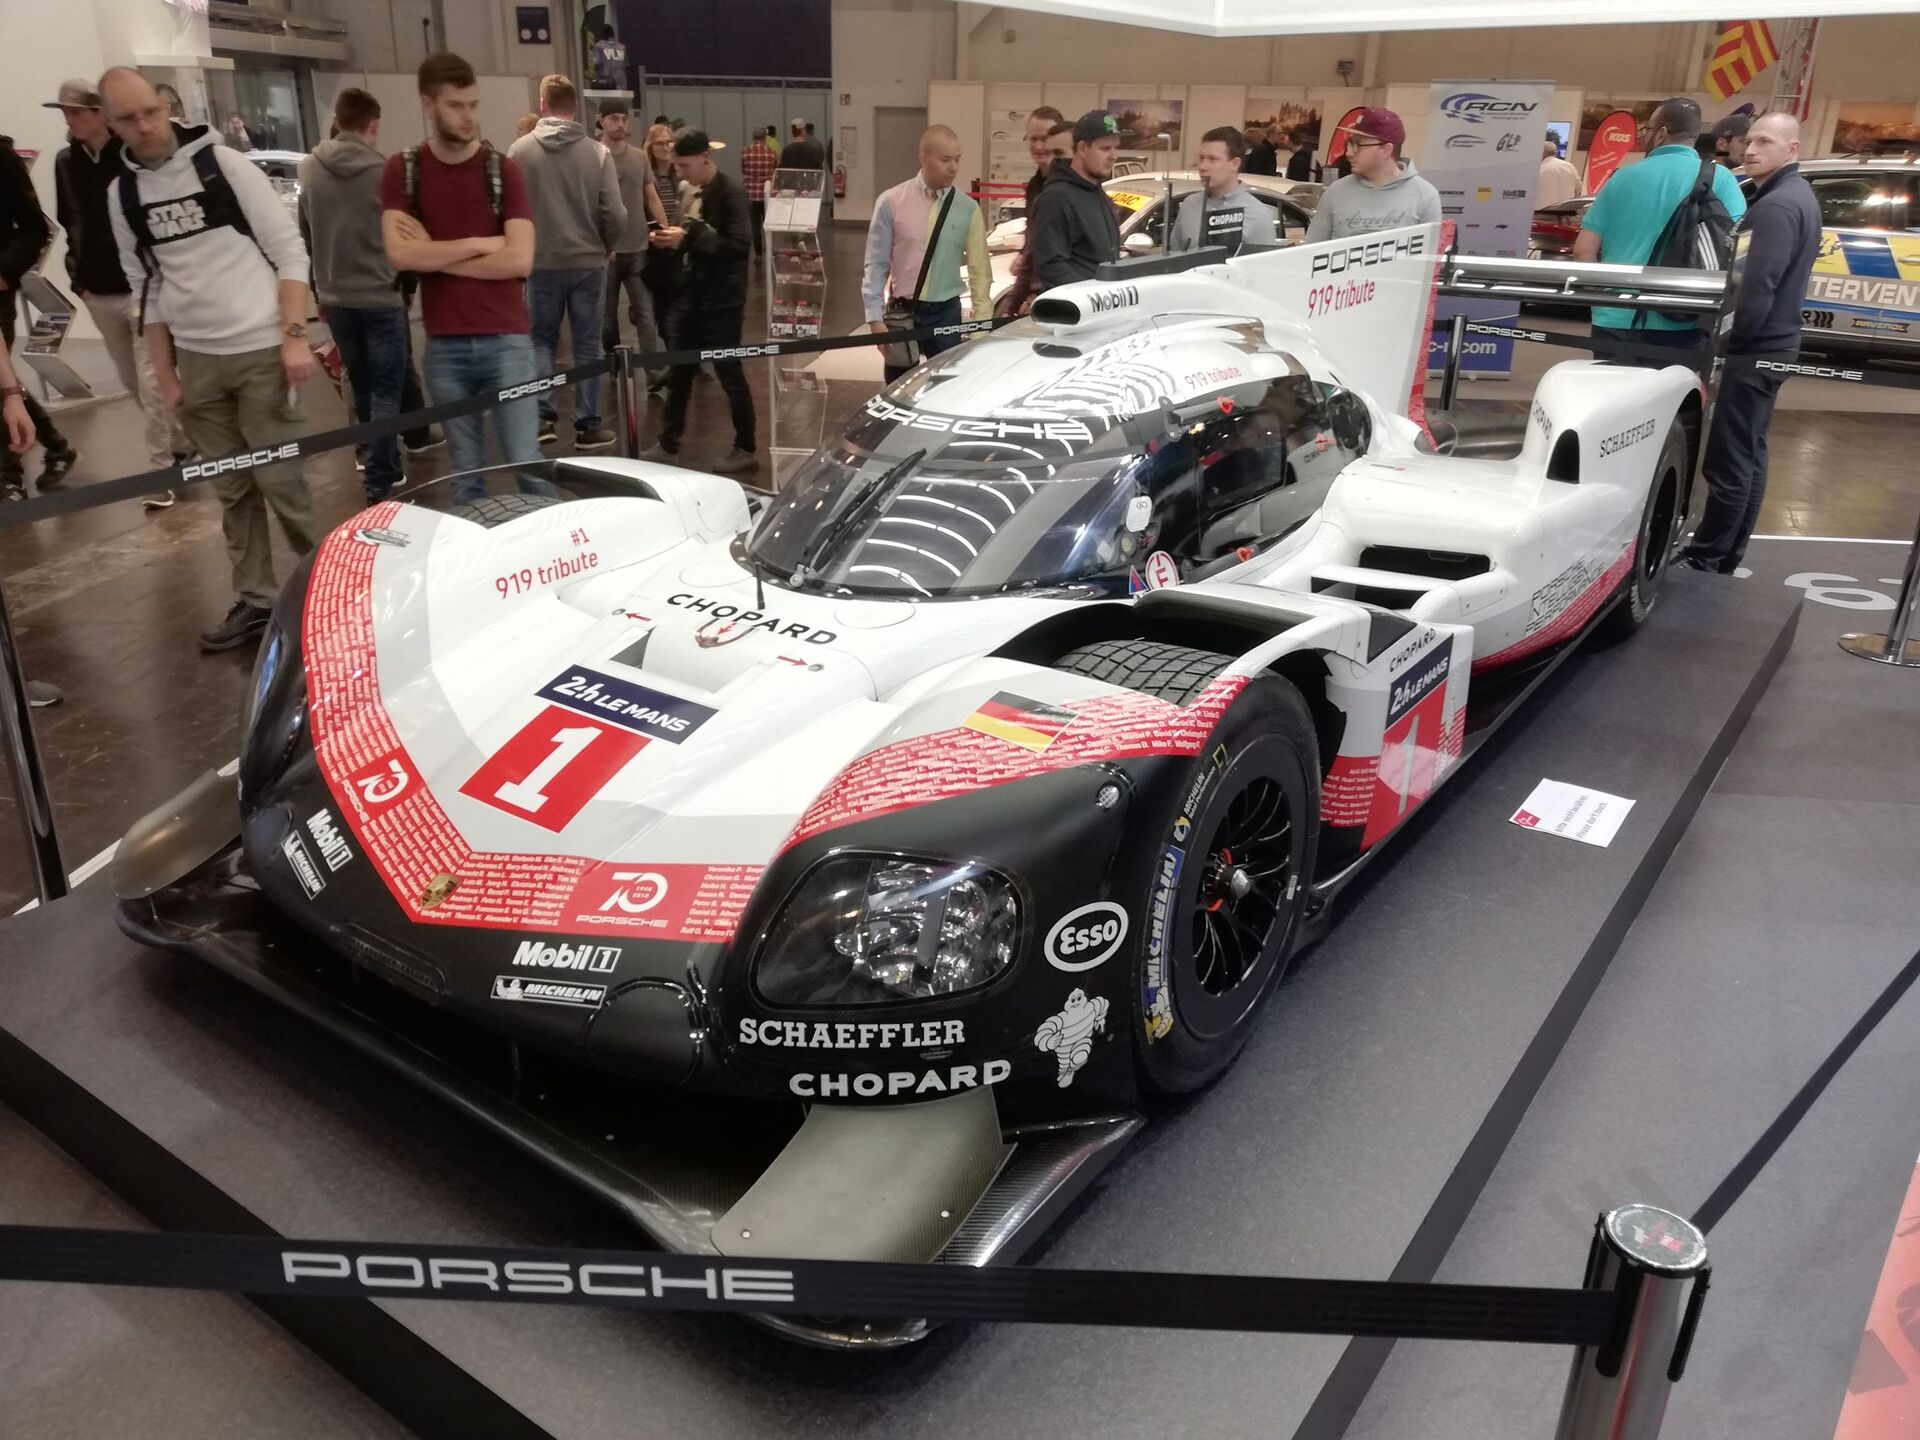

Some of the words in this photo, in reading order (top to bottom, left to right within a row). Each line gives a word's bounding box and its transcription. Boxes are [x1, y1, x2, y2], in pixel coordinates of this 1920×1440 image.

[602, 48, 625, 62] VLN
[1464, 102, 1539, 112] RCN
[147, 199, 205, 221] STAR
[148, 217, 208, 240] WARS
[1209, 212, 1243, 226] CHOPARD
[1311, 234, 1425, 279] PORSCHE
[1086, 288, 1127, 313] Mobil
[1308, 284, 1333, 319] 919
[1335, 278, 1375, 311] tribute
[933, 320, 993, 336] PORSCHE
[1466, 323, 1547, 342] PORSCHE
[700, 344, 780, 361] PORSCHE
[1755, 360, 1863, 381] PORSCHE
[498, 373, 567, 402] PORSCHE
[1184, 371, 1208, 390] 919
[1207, 365, 1243, 384] tribute
[866, 393, 1092, 442] PORSCHE
[1600, 418, 1656, 458] SCHAEFFLER
[182, 443, 299, 481] PORSCHE
[570, 528, 592, 547] #1
[495, 569, 533, 600] 919
[537, 551, 598, 587] tribute
[666, 593, 838, 645] CHOPARD
[1390, 627, 1436, 673] CHOPARD
[1410, 677, 1424, 699] LE
[1422, 656, 1449, 689] MANS
[594, 694, 622, 712] LE
[622, 703, 691, 733] MANS
[494, 726, 604, 814] 1
[1398, 714, 1420, 816] 1
[1183, 772, 1205, 815] MICHELIN
[306, 808, 346, 857] Mobil
[294, 850, 322, 893] MICHELIN
[576, 915, 669, 928] PORSCHE
[1147, 852, 1177, 988] MICHELIN
[512, 941, 593, 971] Mobil
[524, 983, 603, 1001] MICHELIN
[739, 1017, 965, 1049] SCHAEFFLER
[789, 1059, 1011, 1098] CHOPARD
[281, 1251, 795, 1303] PORSCHE
